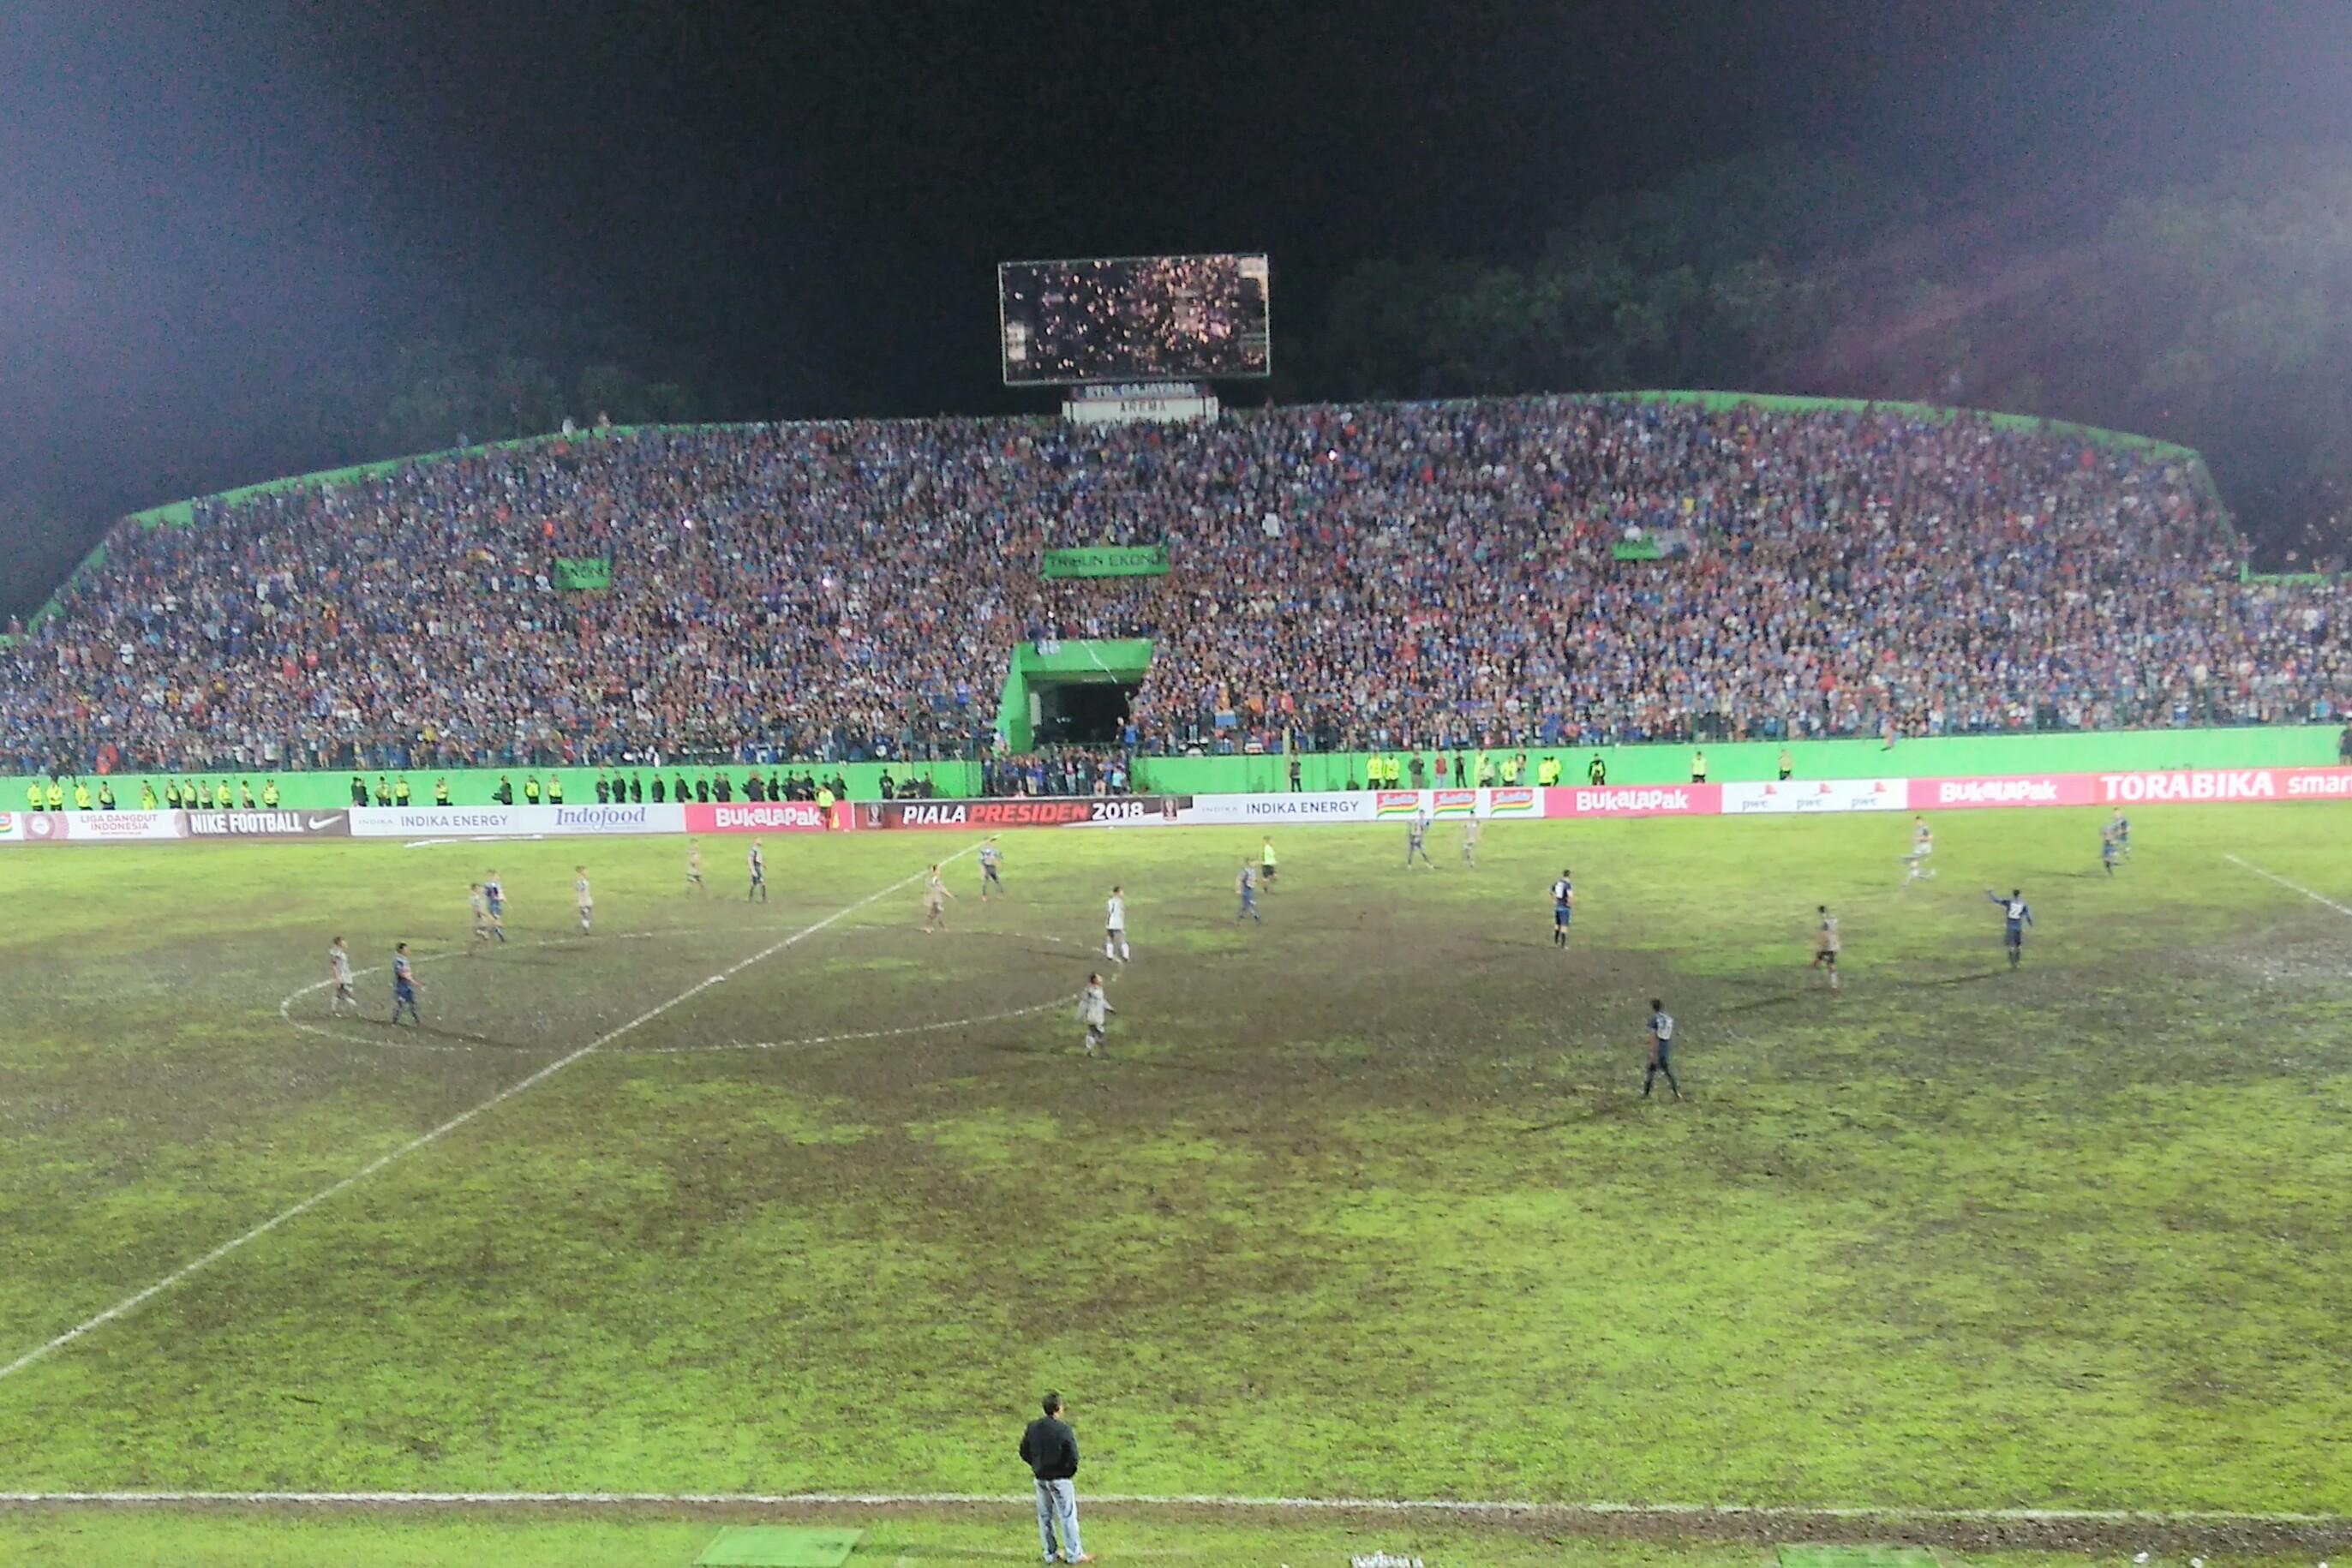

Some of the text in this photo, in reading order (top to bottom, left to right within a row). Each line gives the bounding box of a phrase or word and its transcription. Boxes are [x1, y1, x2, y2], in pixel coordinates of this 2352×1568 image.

[2100, 771, 2352, 801] TORABIKA smar
[1246, 801, 1359, 814] INDIKA ENERGY
[1742, 799, 1768, 811] pwc
[1796, 798, 1823, 811] pwc
[1851, 796, 1878, 809] pwc
[81, 813, 158, 823] LIGA DANGDUT
[556, 806, 646, 831] Indofood
[902, 801, 1145, 825] PIALA PRESIDEN 2018
[91, 822, 150, 831] INDONESIA
[190, 813, 304, 834] NIKE FOOTBALL
[401, 815, 508, 828] INDIKA ENERGY
